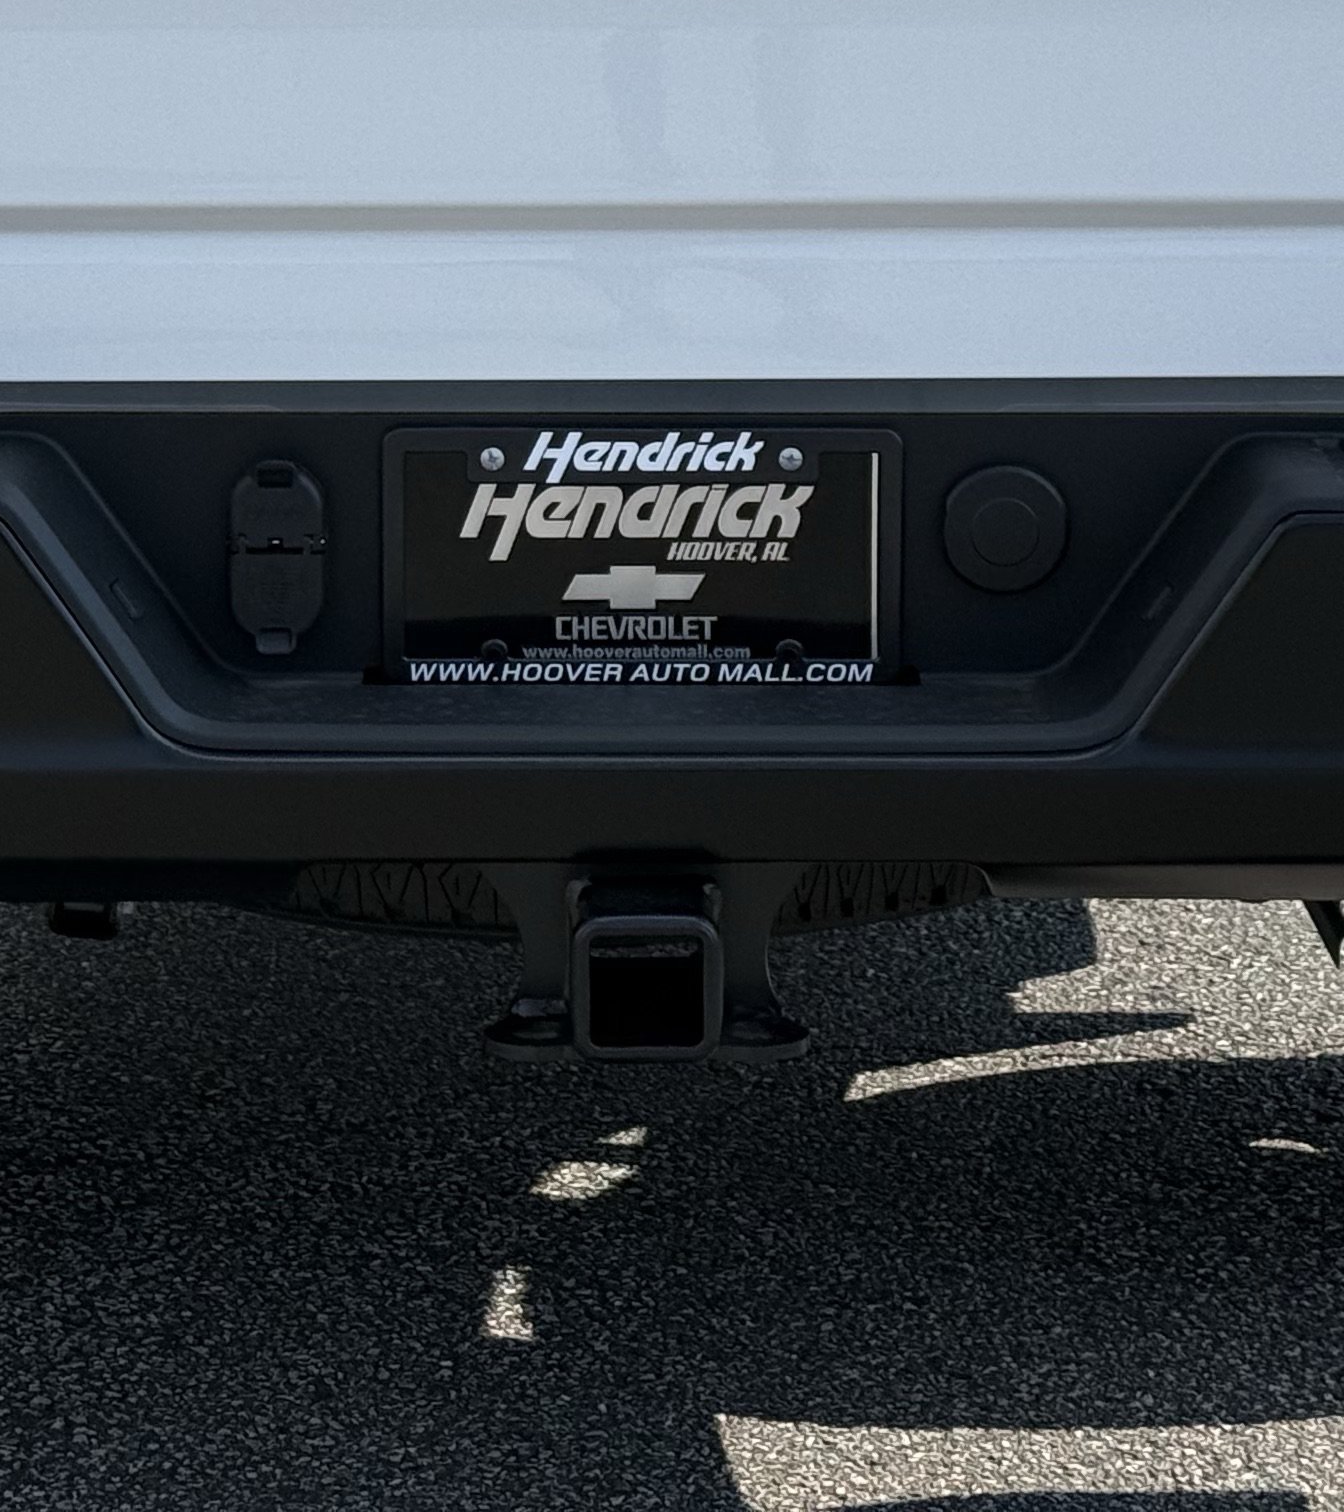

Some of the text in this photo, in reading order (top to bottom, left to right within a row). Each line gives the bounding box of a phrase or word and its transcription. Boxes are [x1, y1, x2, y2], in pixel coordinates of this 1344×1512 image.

[523, 431, 764, 483] Hendrick
[459, 483, 814, 562] Hendrick
[667, 542, 790, 564] HOOVER, AL
[555, 615, 718, 642] CHEVROLET
[522, 643, 751, 660] www.hooverautomall.com
[410, 662, 874, 684] WWW.HOOVER AUTO MALL.COM
